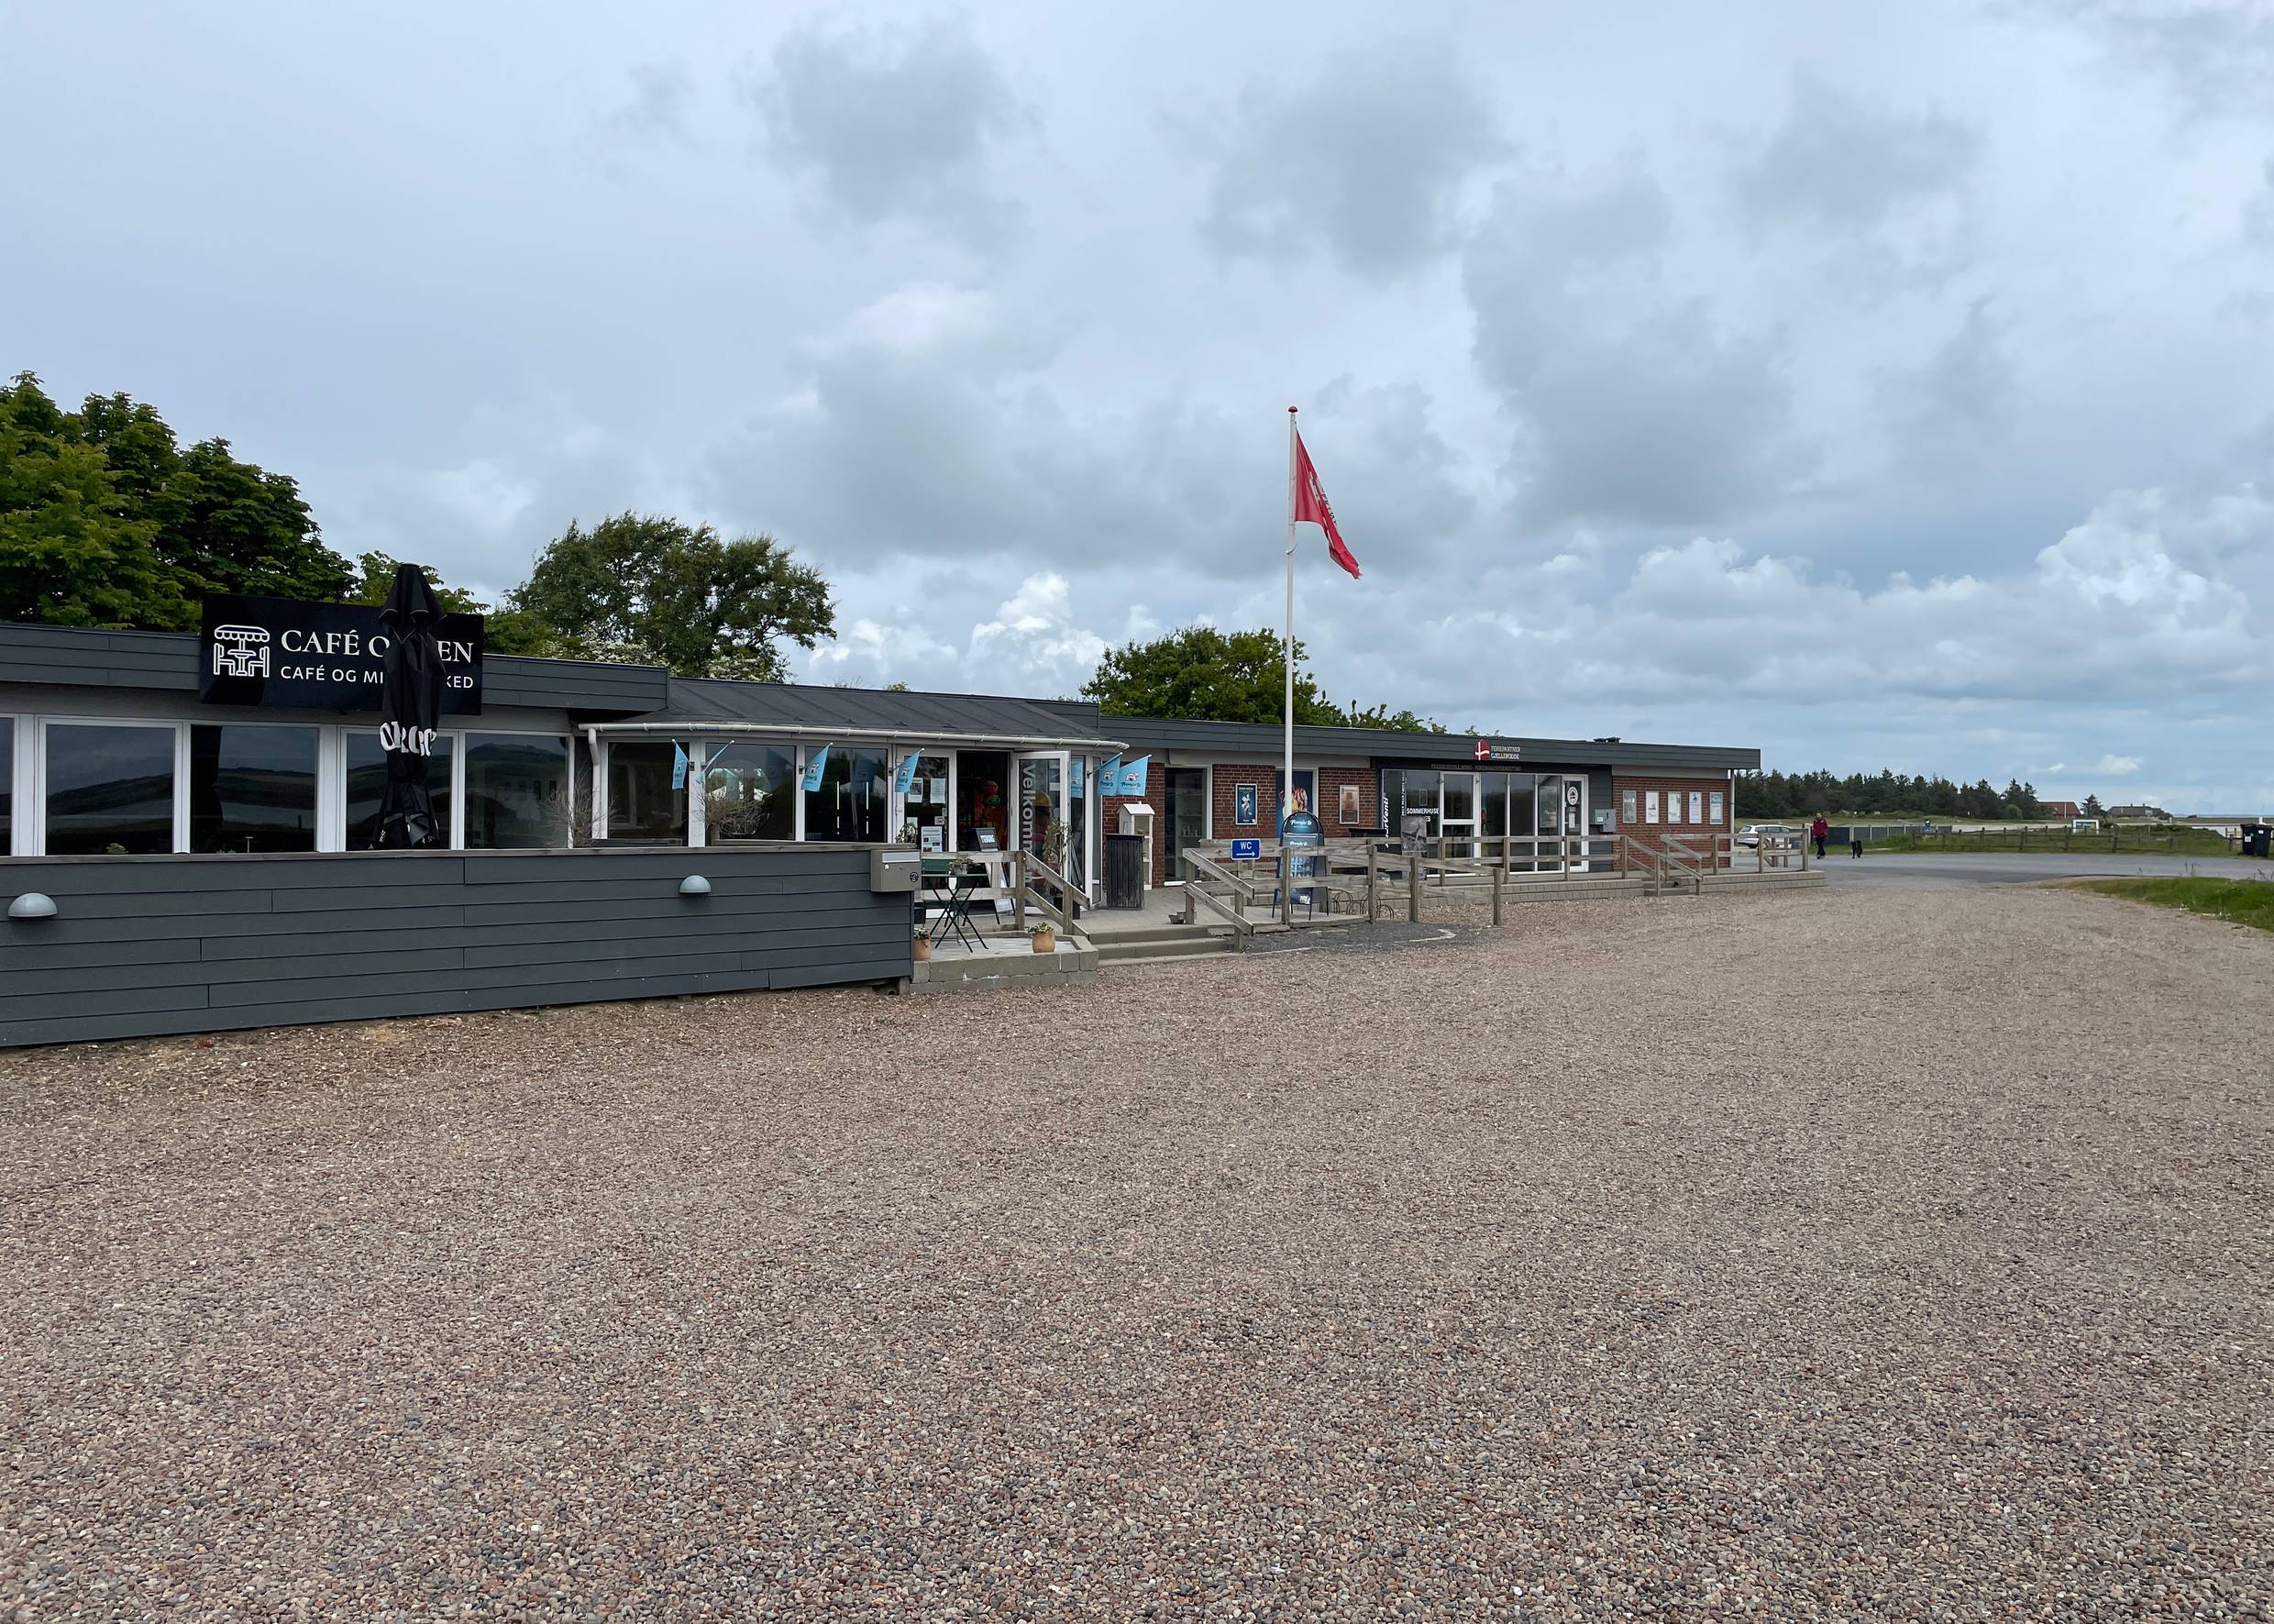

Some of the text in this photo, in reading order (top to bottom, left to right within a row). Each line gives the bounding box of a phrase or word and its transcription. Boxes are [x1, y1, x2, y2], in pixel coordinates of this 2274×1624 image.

[281, 629, 475, 663] CAFÉ OEN
[280, 664, 326, 681] CAFÉ
[331, 668, 357, 682] OG
[1022, 764, 1036, 883] Velkommn
[1240, 841, 1253, 850] WC
